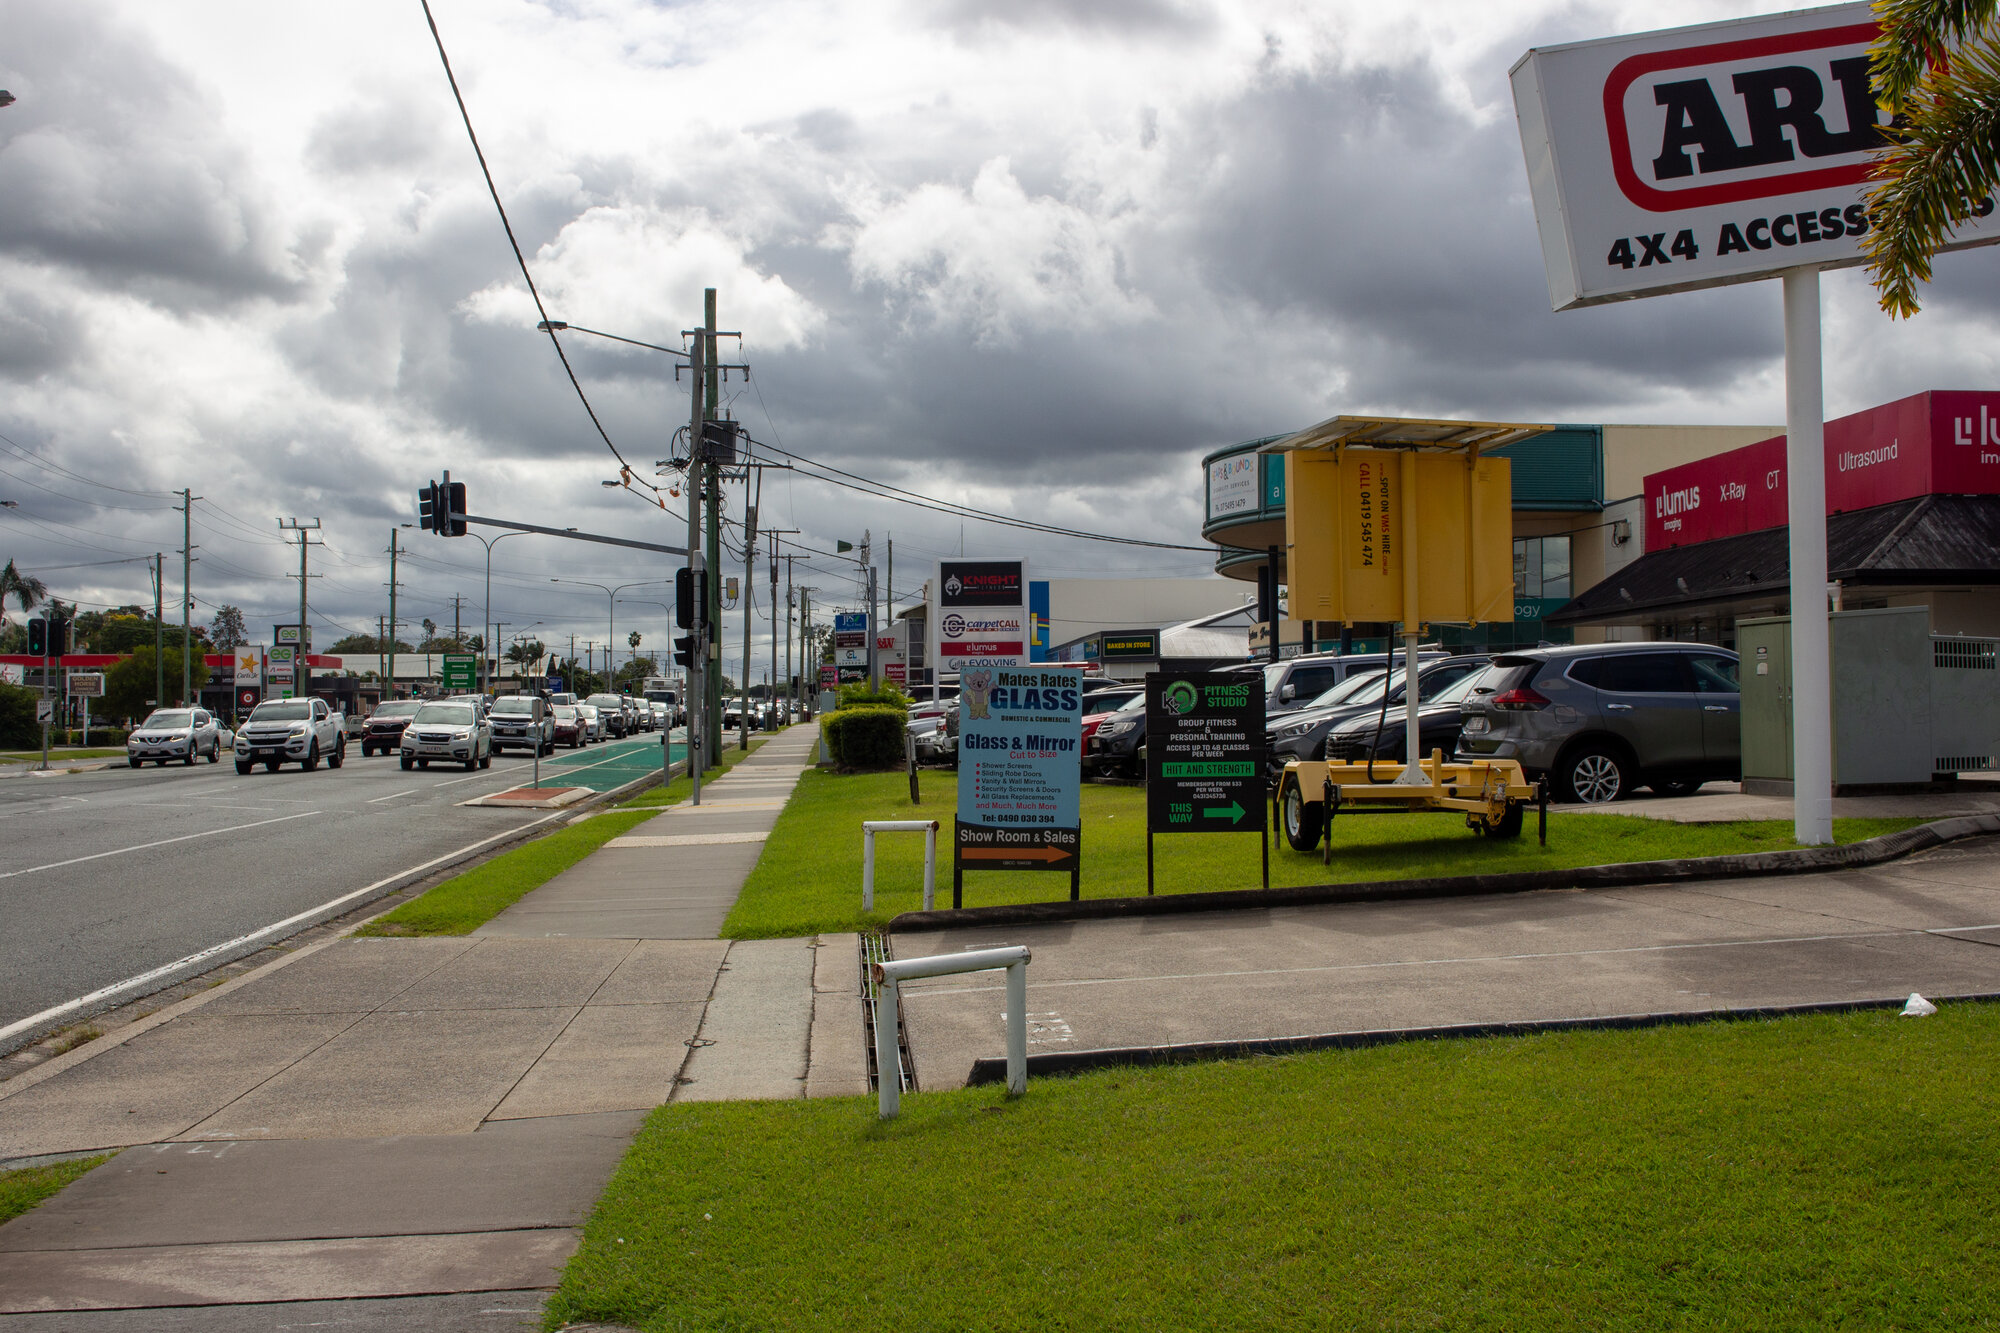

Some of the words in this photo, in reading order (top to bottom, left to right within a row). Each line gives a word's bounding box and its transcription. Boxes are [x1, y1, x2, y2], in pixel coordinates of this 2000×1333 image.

[1607, 229, 1699, 270] 4X4
[1716, 194, 1995, 256] ACCESSES
[1839, 439, 1898, 472] Ultrasound
[1360, 462, 1370, 489] CALL
[1766, 469, 1780, 490] CT
[1720, 482, 1747, 502] X-Ray
[1360, 491, 1371, 520] 0419
[1663, 484, 1700, 516] lumus
[1663, 518, 1682, 531] imaging
[1361, 522, 1372, 543] 545
[1362, 544, 1373, 566] 474
[963, 575, 1018, 585] KNIGHT
[971, 643, 997, 651] lumus
[969, 658, 1017, 667] EVOLVING
[998, 673, 1038, 687] Mates
[1040, 673, 1077, 688] Rates
[1204, 685, 1250, 696] FITNESS
[990, 688, 1078, 711] GLASS
[1207, 697, 1247, 707] STUDIO
[1178, 719, 1205, 727] GROUP
[965, 734, 1008, 749] Glass
[1011, 737, 1023, 750] &
[1026, 735, 1076, 751] Mirror
[1009, 751, 1025, 759] Cut
[1038, 750, 1057, 758] Size
[1166, 765, 1183, 774] HIIT
[1186, 765, 1204, 774] AND
[1207, 764, 1251, 774] STRENGTH
[1016, 802, 1037, 810] Much
[1169, 803, 1192, 812] THIS
[982, 814, 997, 822] Tel:
[1021, 815, 1038, 823] 030
[1039, 815, 1055, 823] 394
[1169, 813, 1193, 823] WAY
[960, 829, 993, 842] Show
[996, 830, 1031, 842] Room
[1034, 832, 1040, 842] &
[1043, 830, 1076, 844] Sales
